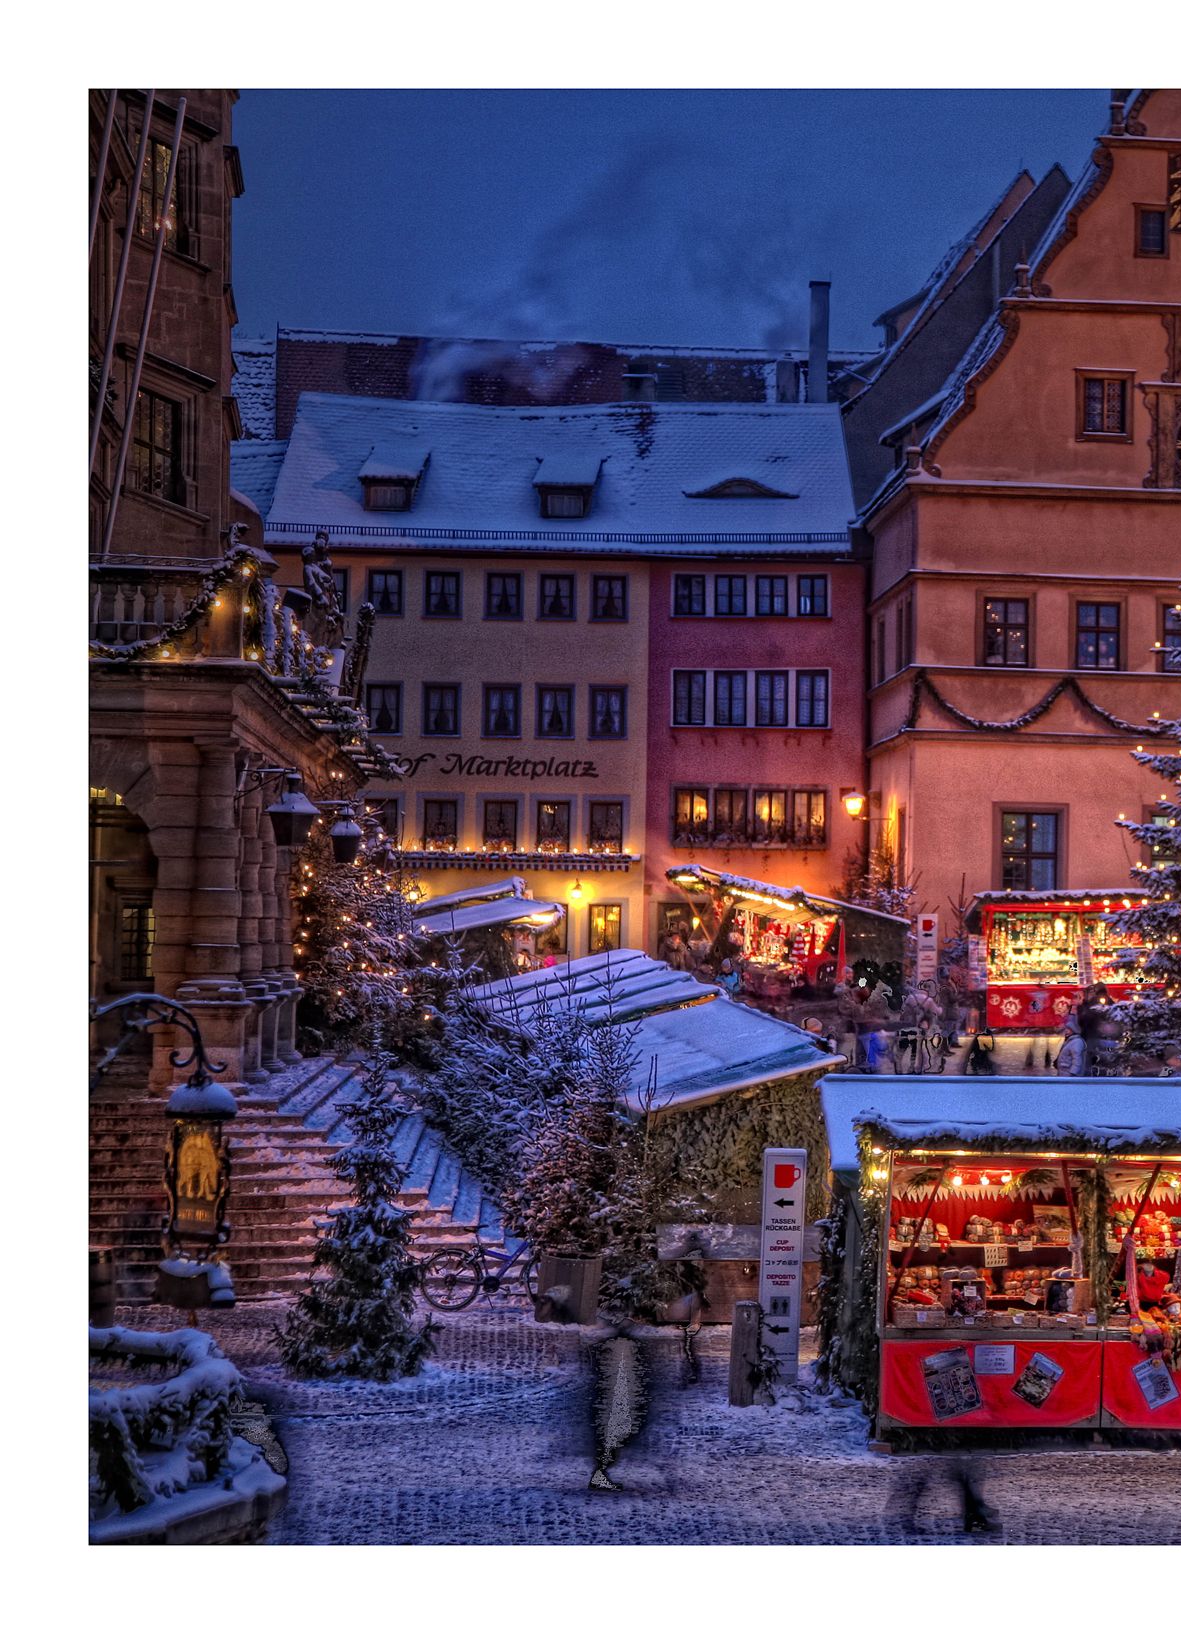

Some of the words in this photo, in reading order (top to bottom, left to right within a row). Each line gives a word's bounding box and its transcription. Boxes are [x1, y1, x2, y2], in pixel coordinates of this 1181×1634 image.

[394, 753, 436, 778] of
[440, 753, 600, 781] Marktplatz
[765, 1224, 801, 1232] RÜCKGABE
